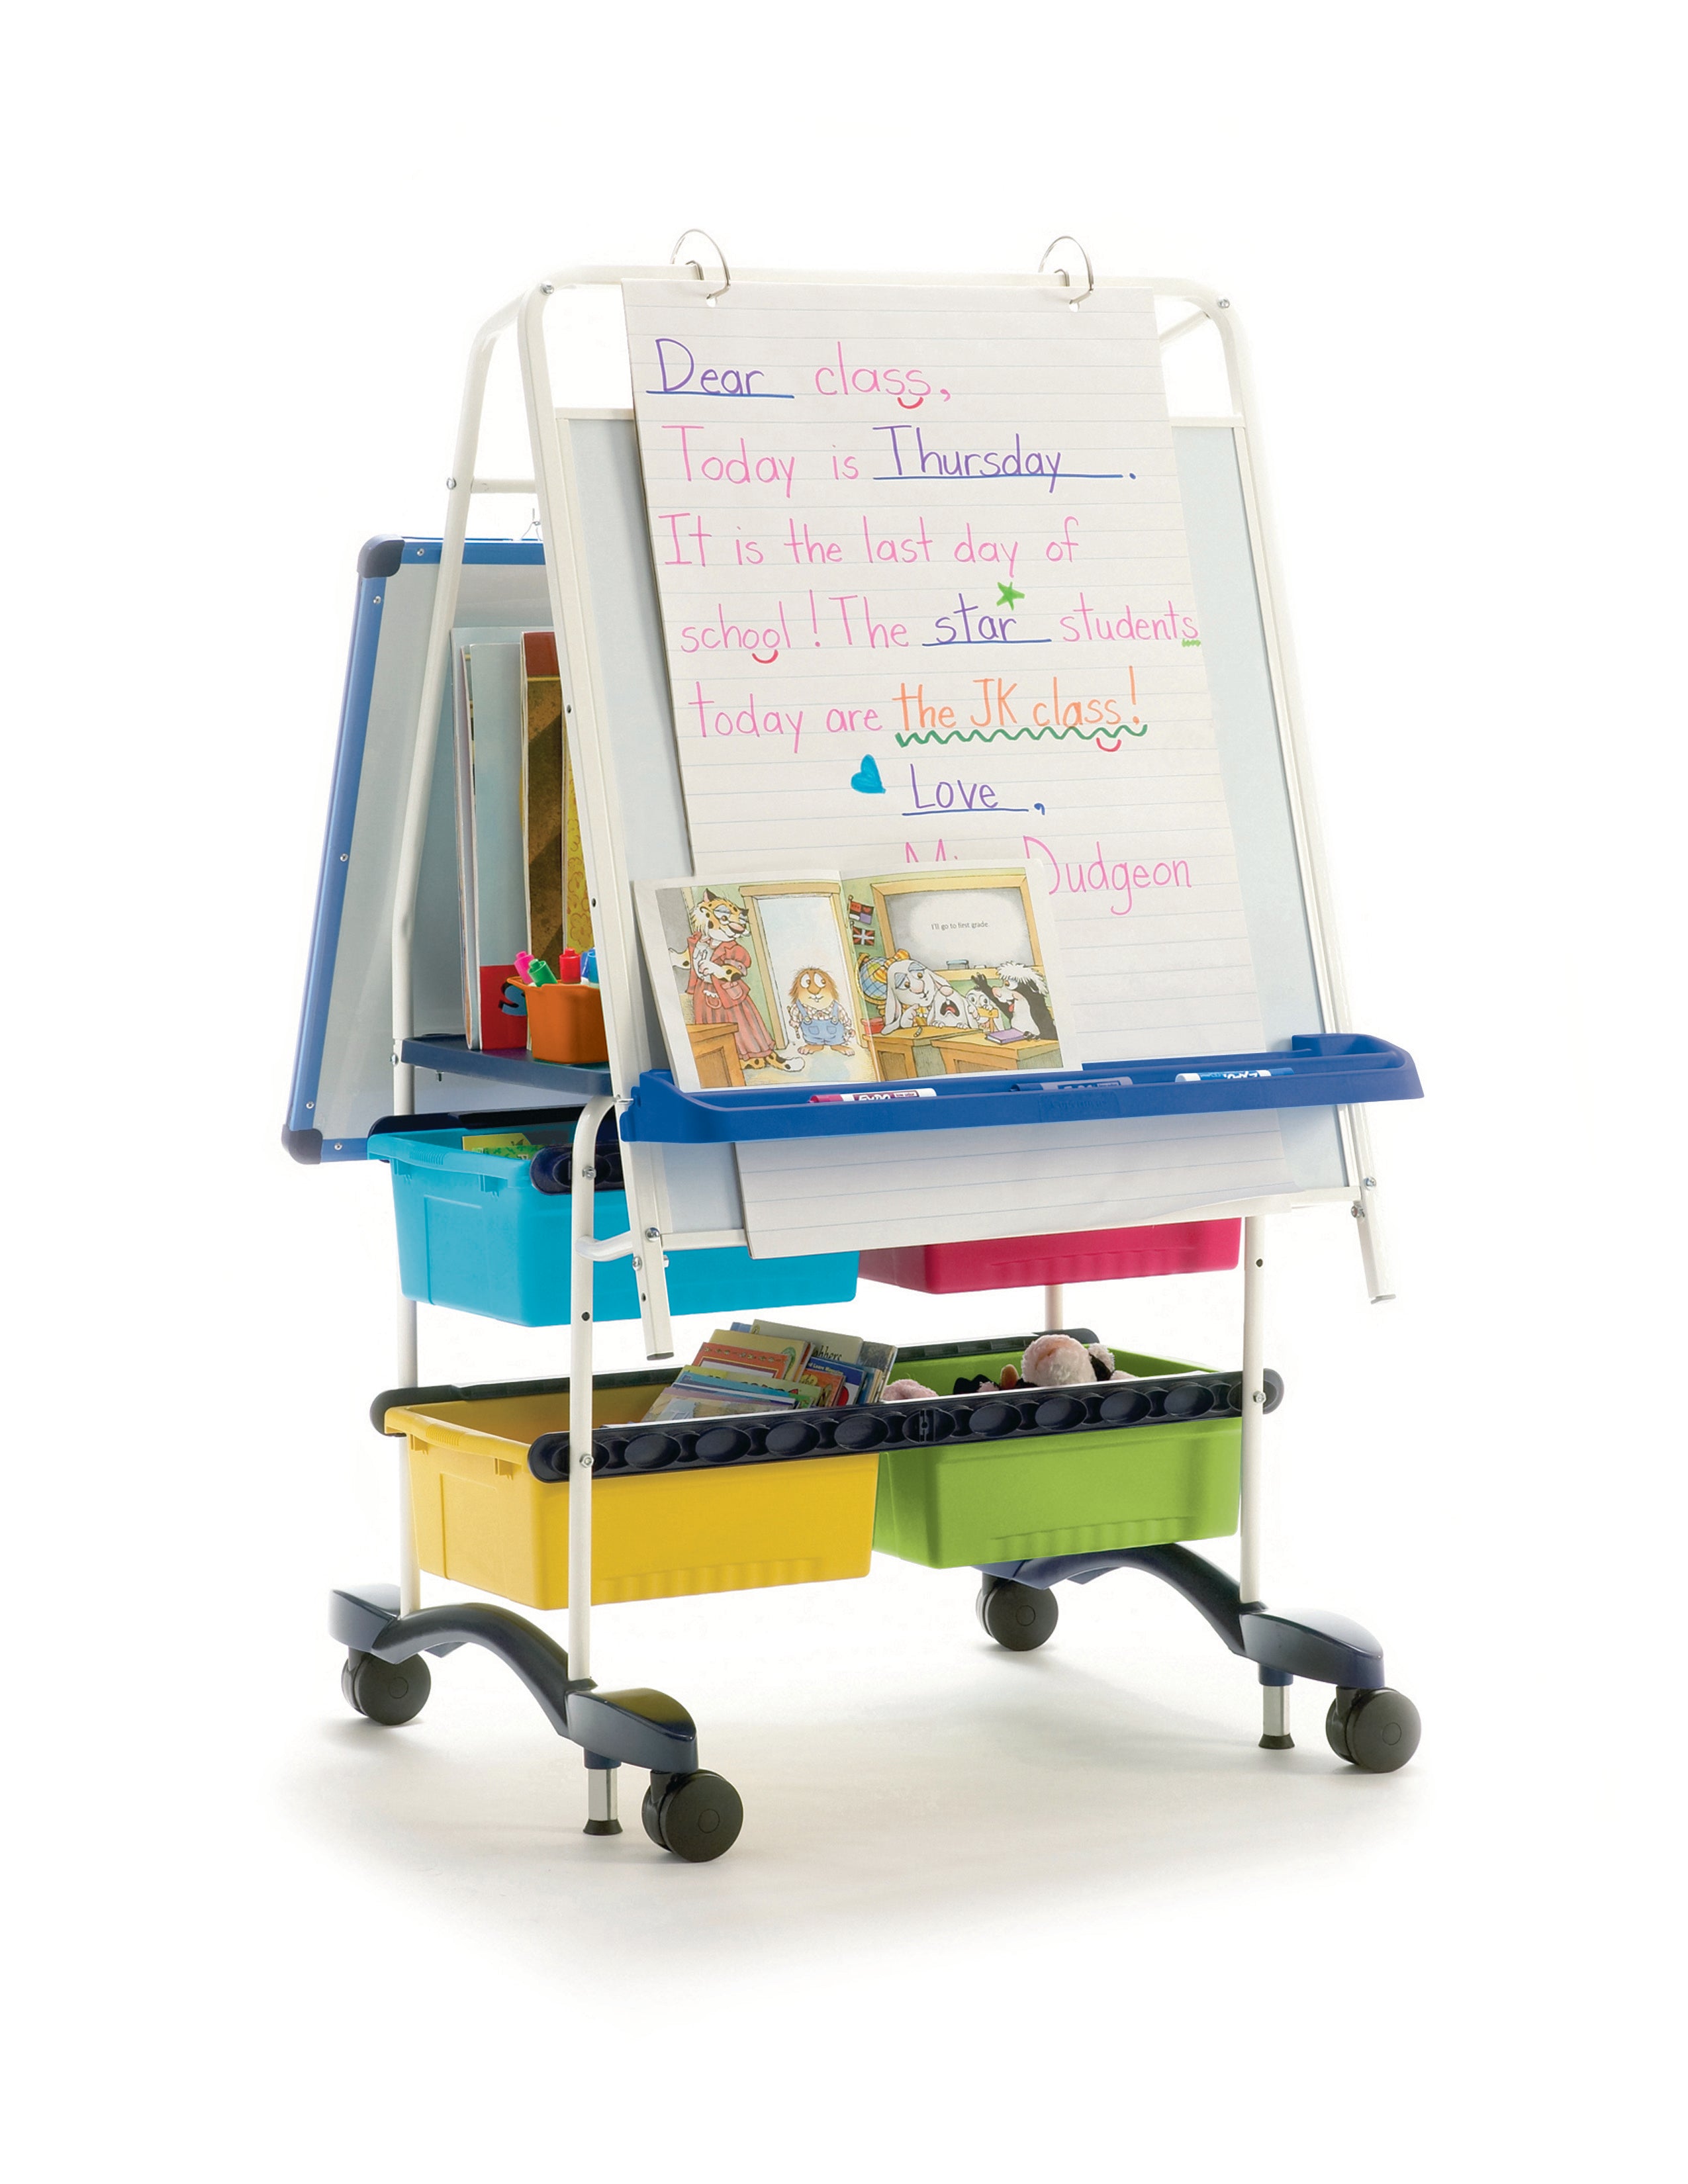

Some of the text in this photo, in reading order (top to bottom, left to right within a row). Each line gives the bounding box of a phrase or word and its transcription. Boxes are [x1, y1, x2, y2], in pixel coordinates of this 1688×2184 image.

[655, 338, 951, 402] Dear class,
[662, 425, 795, 498] Today
[832, 445, 859, 480] is
[659, 512, 1079, 578] It is the last day of
[828, 595, 909, 649] The
[935, 593, 1017, 644] star
[1060, 592, 1199, 642] students
[688, 665, 1140, 753] today are the JK class!
[1023, 836, 1192, 915] Dudgeon
